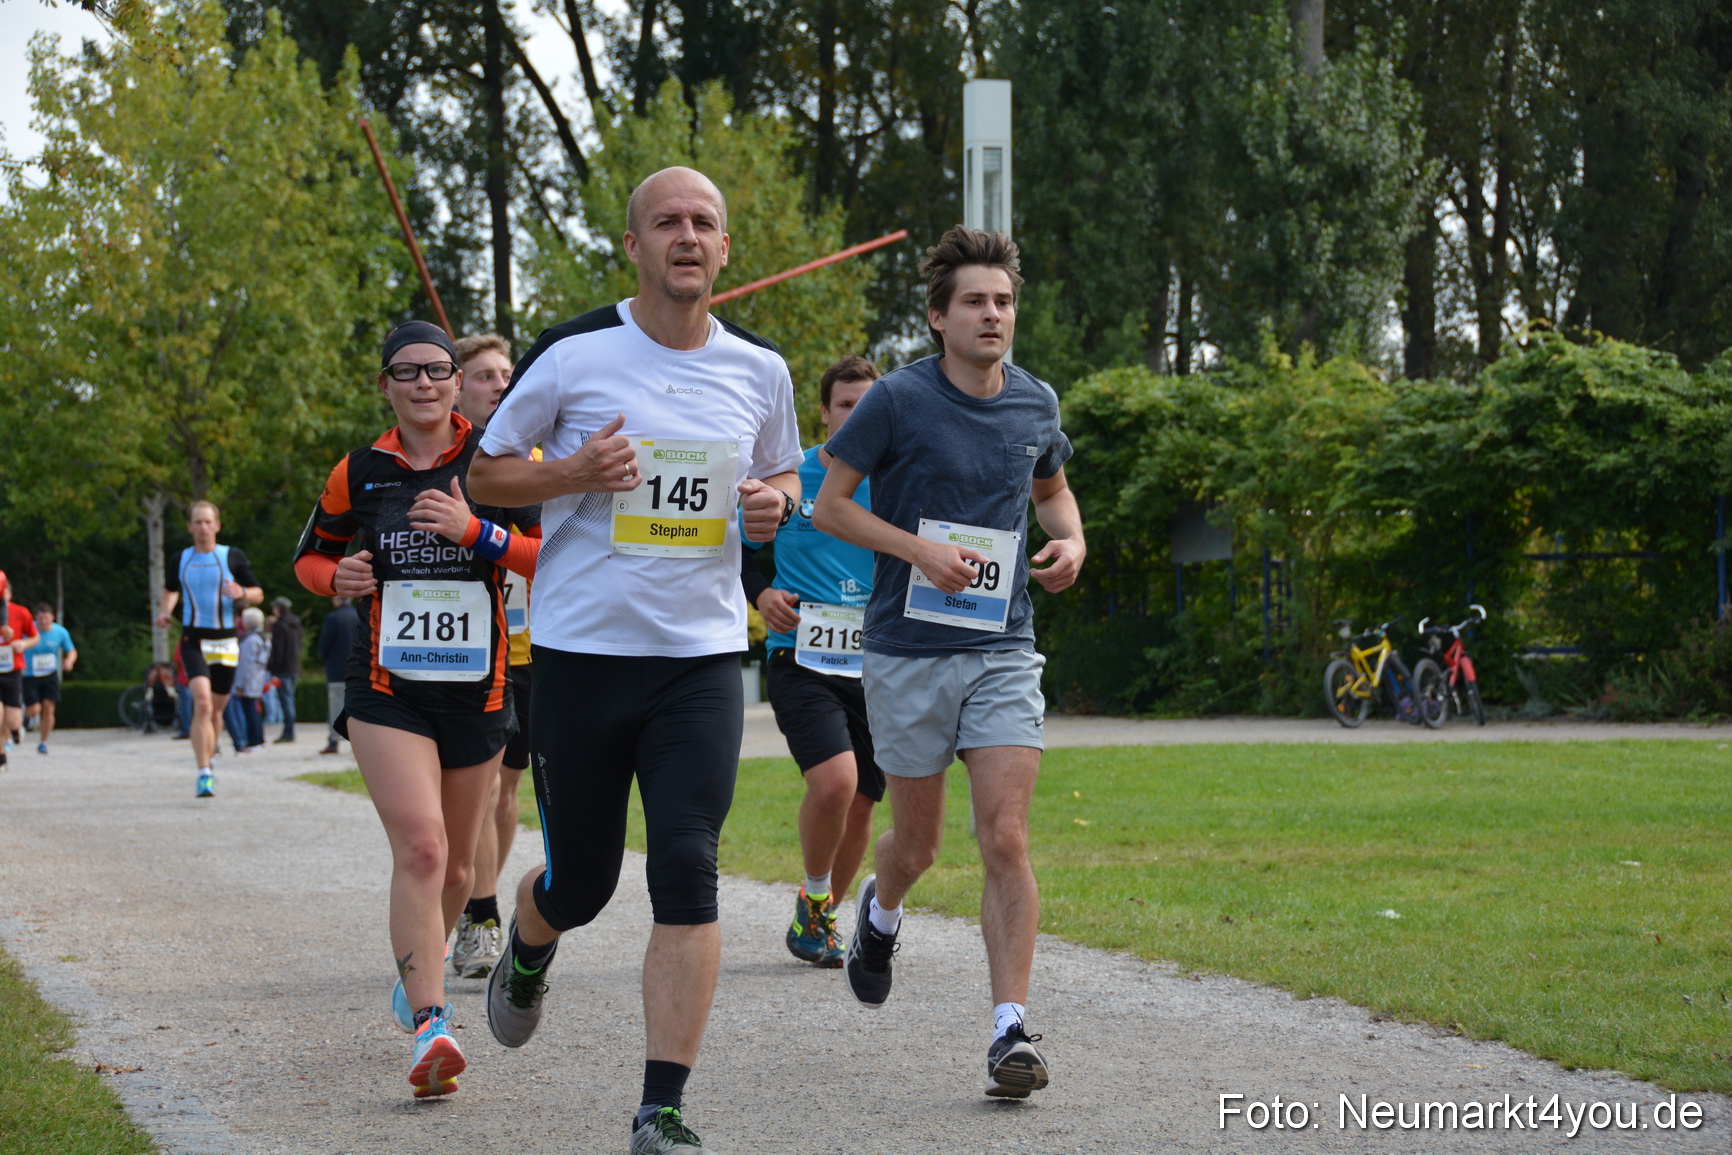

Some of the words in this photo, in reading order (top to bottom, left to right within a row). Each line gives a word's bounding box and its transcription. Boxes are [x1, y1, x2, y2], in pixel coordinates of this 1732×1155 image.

[665, 450, 707, 461] BOCK
[647, 475, 709, 512] 145
[650, 523, 698, 539] Stephan
[959, 535, 993, 547] BOCK
[390, 546, 474, 565] DESIGN
[839, 579, 861, 594] 18.
[422, 590, 460, 599] BOCK
[944, 595, 977, 611] Stefan
[397, 611, 469, 641] 2181
[808, 625, 863, 650] 2119
[400, 651, 469, 664] Ann-Christin
[821, 655, 849, 665] Patrick
